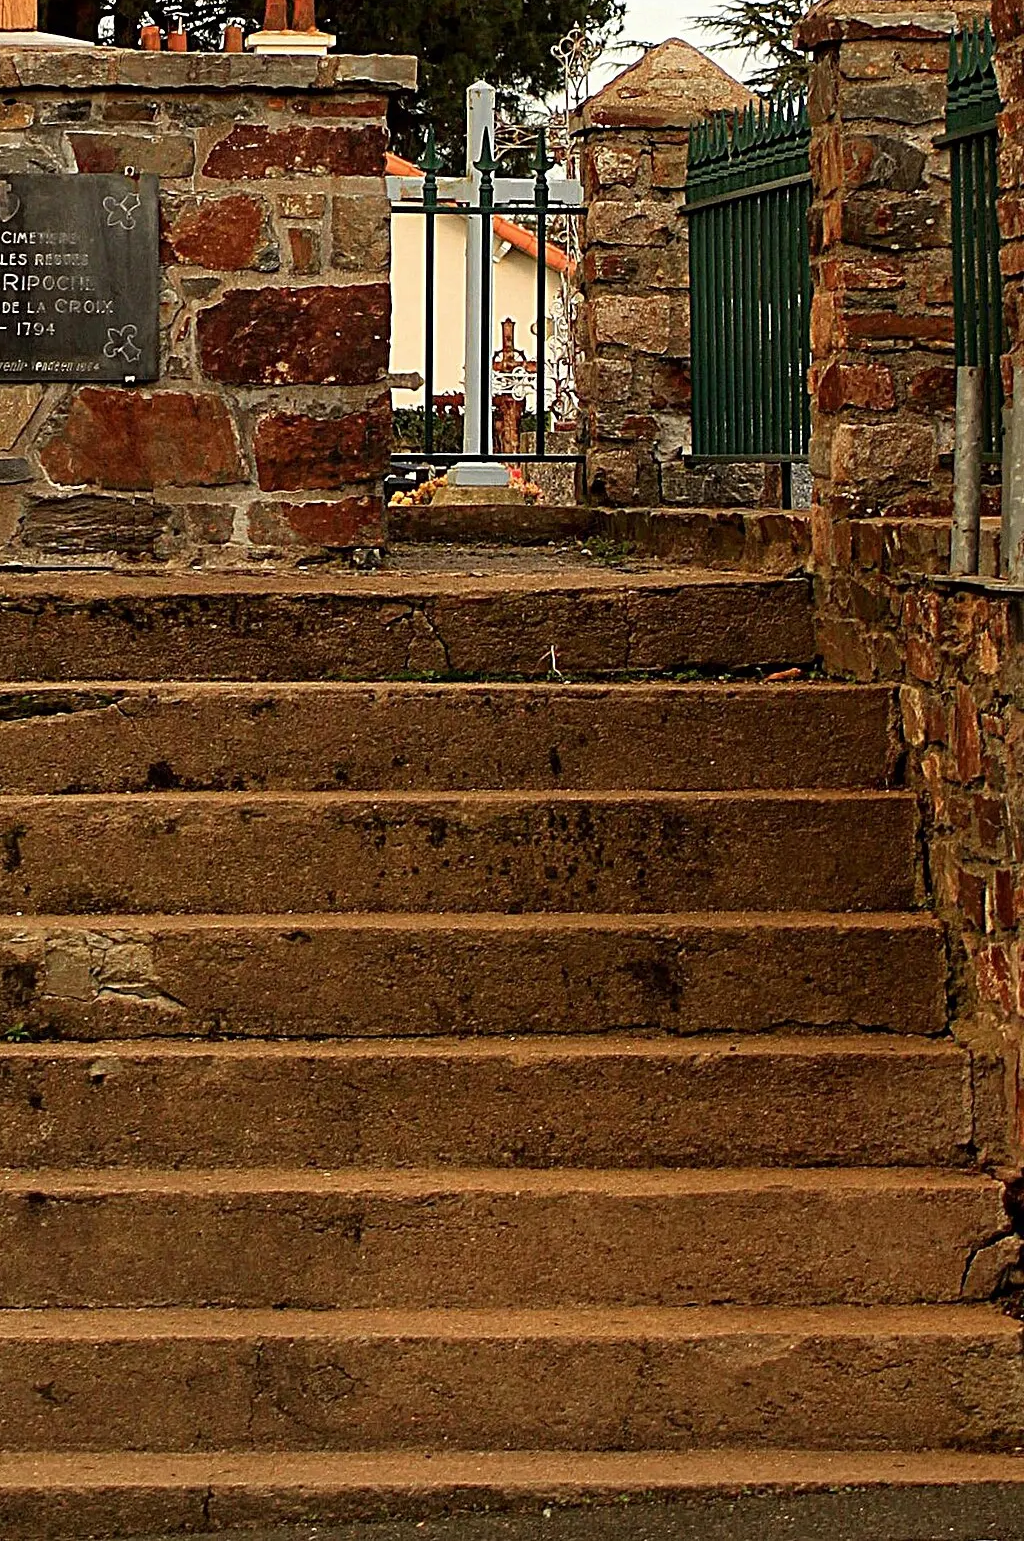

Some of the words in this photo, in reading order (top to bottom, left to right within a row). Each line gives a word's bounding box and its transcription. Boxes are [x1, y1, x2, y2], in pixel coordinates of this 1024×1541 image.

[0, 253, 28, 266] LES
[34, 253, 89, 266] RESTES
[2, 273, 96, 291] RIPOCHE
[2, 301, 20, 314] DE
[26, 301, 46, 314] LA
[54, 298, 114, 314] CROIX
[16, 322, 56, 336] 1794
